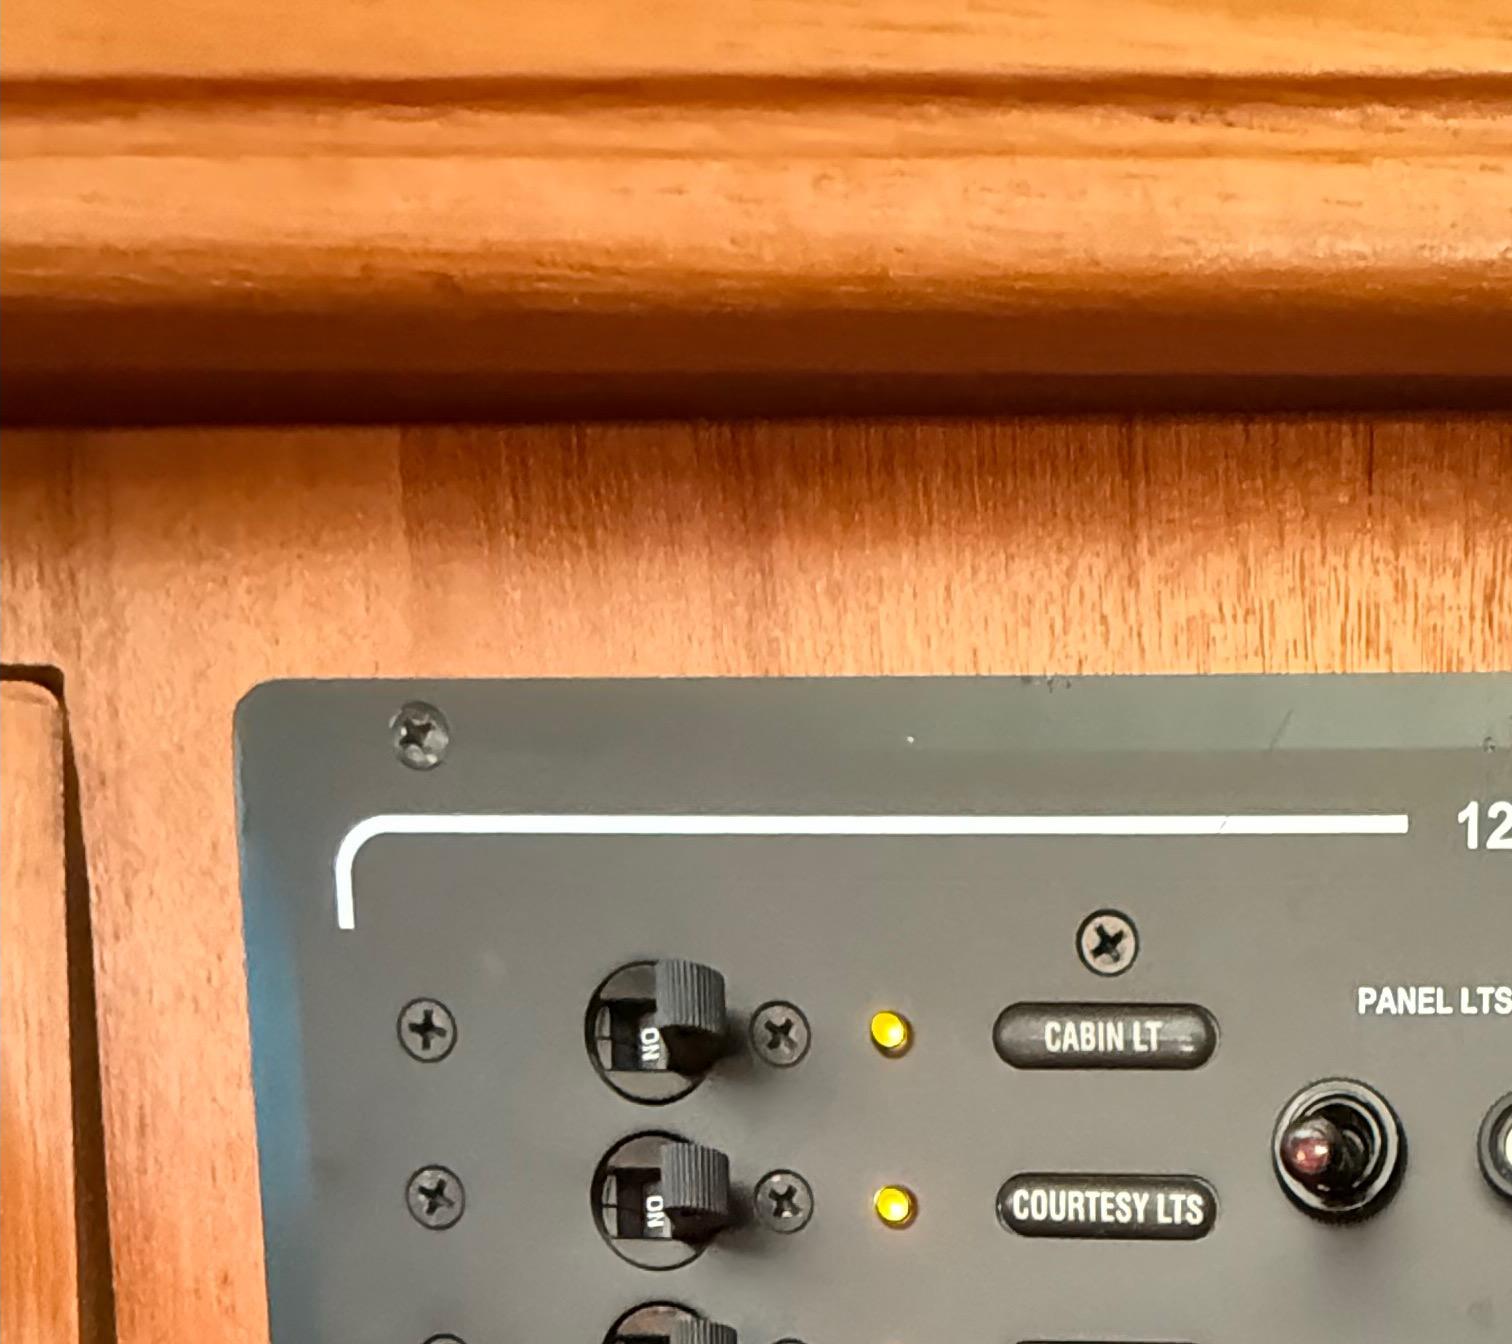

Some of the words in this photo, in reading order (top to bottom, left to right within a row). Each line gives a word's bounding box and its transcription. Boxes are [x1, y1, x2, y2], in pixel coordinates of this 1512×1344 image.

[1358, 986, 1454, 1015] PANEL
[640, 1026, 661, 1061] ON
[1043, 1020, 1124, 1052] CABIN
[1132, 1020, 1164, 1052] LT
[647, 1195, 665, 1229] ON
[1008, 1188, 1150, 1223] COURTESY
[1154, 1191, 1204, 1225] LTS
